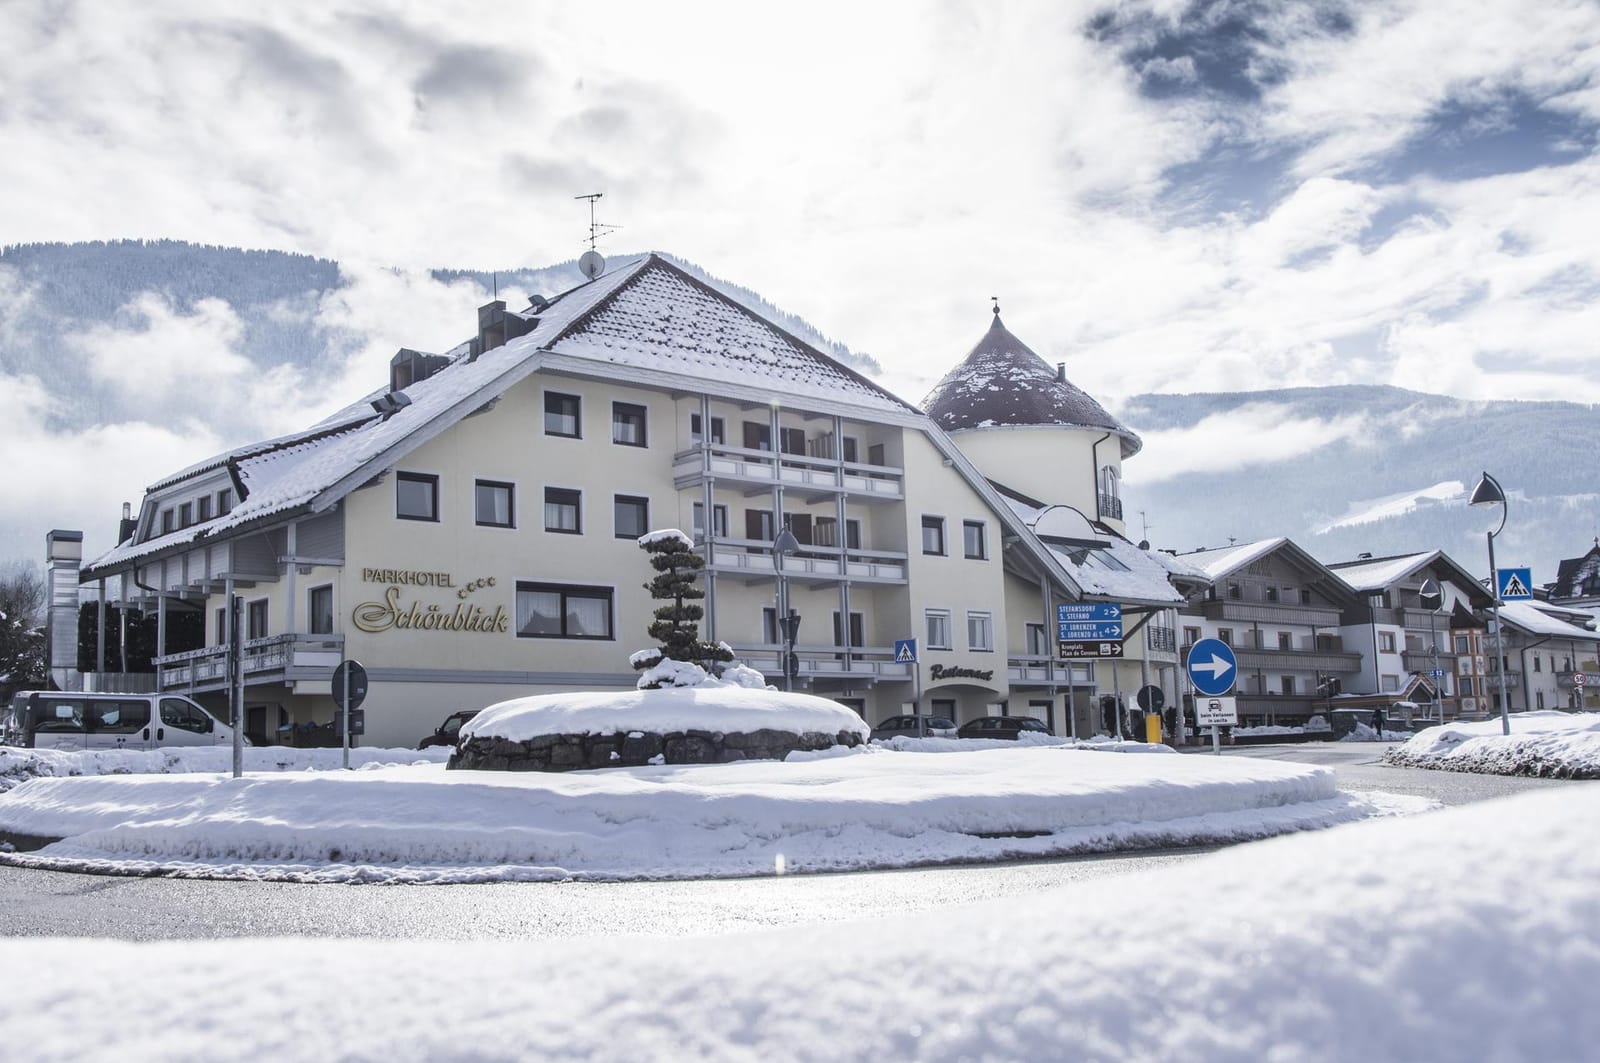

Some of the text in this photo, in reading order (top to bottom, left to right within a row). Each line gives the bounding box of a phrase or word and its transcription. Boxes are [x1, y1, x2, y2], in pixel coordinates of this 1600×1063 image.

[363, 568, 456, 588] PARKHOTEL
[353, 586, 508, 633] Schönblick
[1103, 608, 1110, 616] 2
[1070, 623, 1097, 631] LORENZEN
[930, 664, 993, 681] Restaurant
